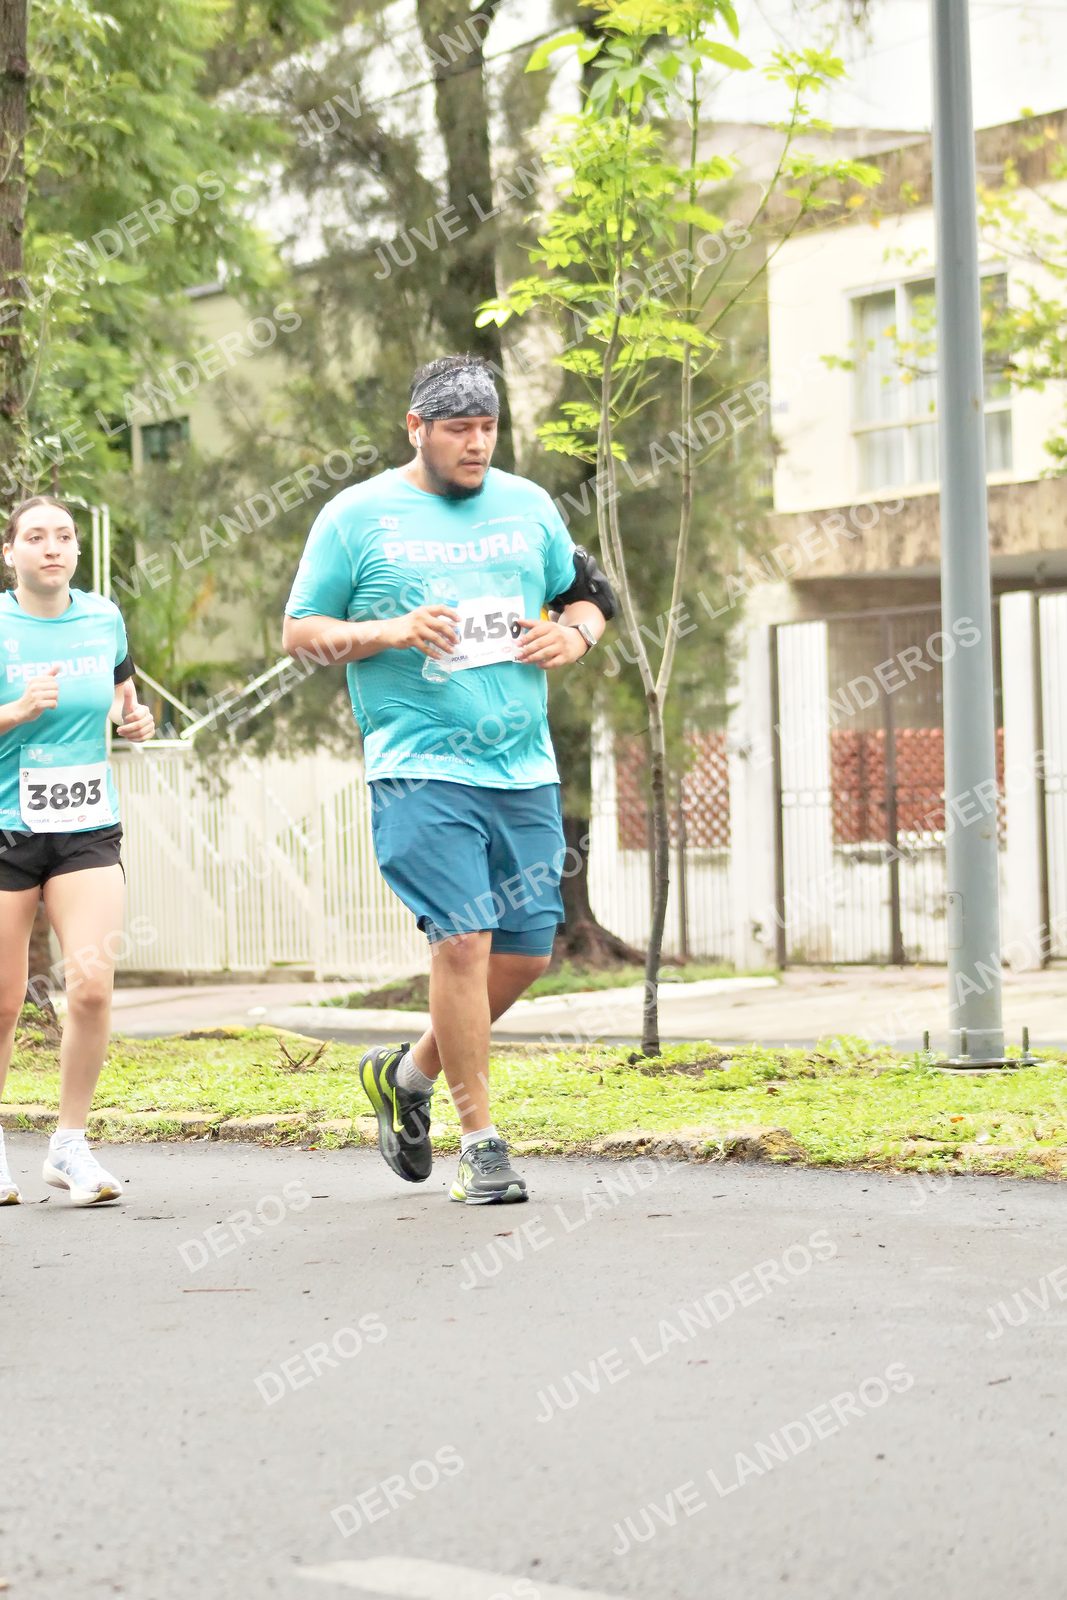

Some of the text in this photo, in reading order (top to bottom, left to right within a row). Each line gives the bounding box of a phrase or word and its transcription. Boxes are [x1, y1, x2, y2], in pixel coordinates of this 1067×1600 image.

[381, 530, 529, 564] PERDURA
[458, 611, 520, 643] 456
[6, 655, 110, 683] PERDURA
[27, 779, 101, 810] 3893
